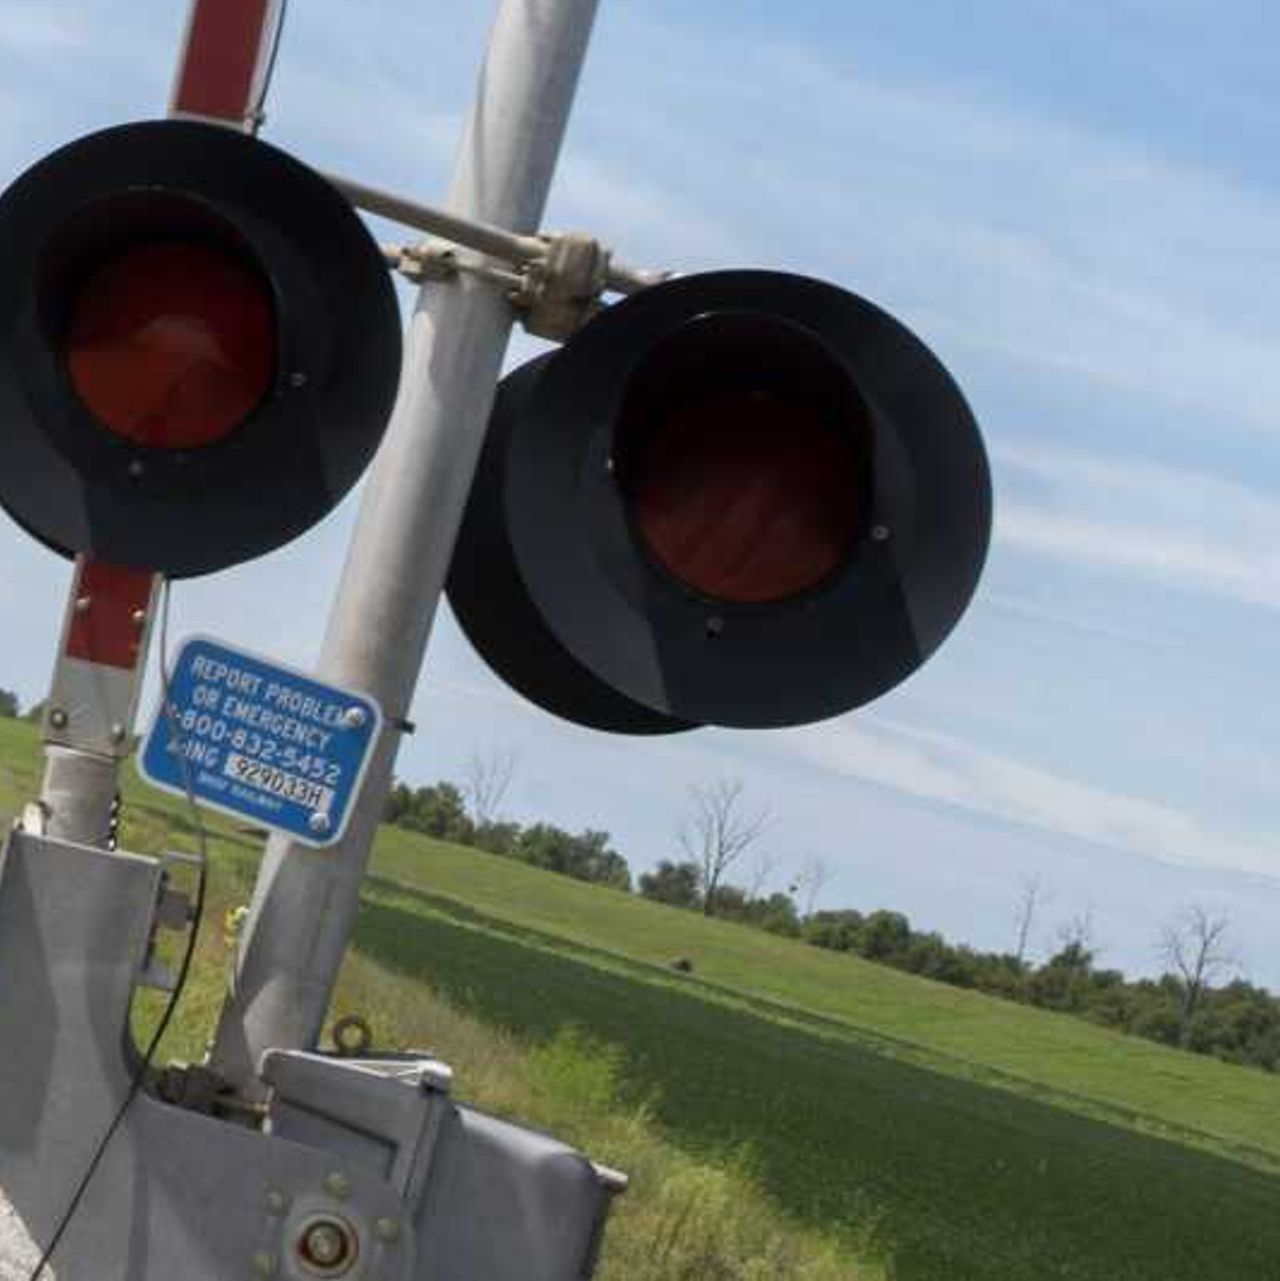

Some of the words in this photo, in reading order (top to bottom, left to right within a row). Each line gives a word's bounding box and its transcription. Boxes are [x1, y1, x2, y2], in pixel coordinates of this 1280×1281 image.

[191, 655, 263, 696] REPORT
[192, 685, 221, 710] OR
[222, 695, 334, 751] EMERGENCY
